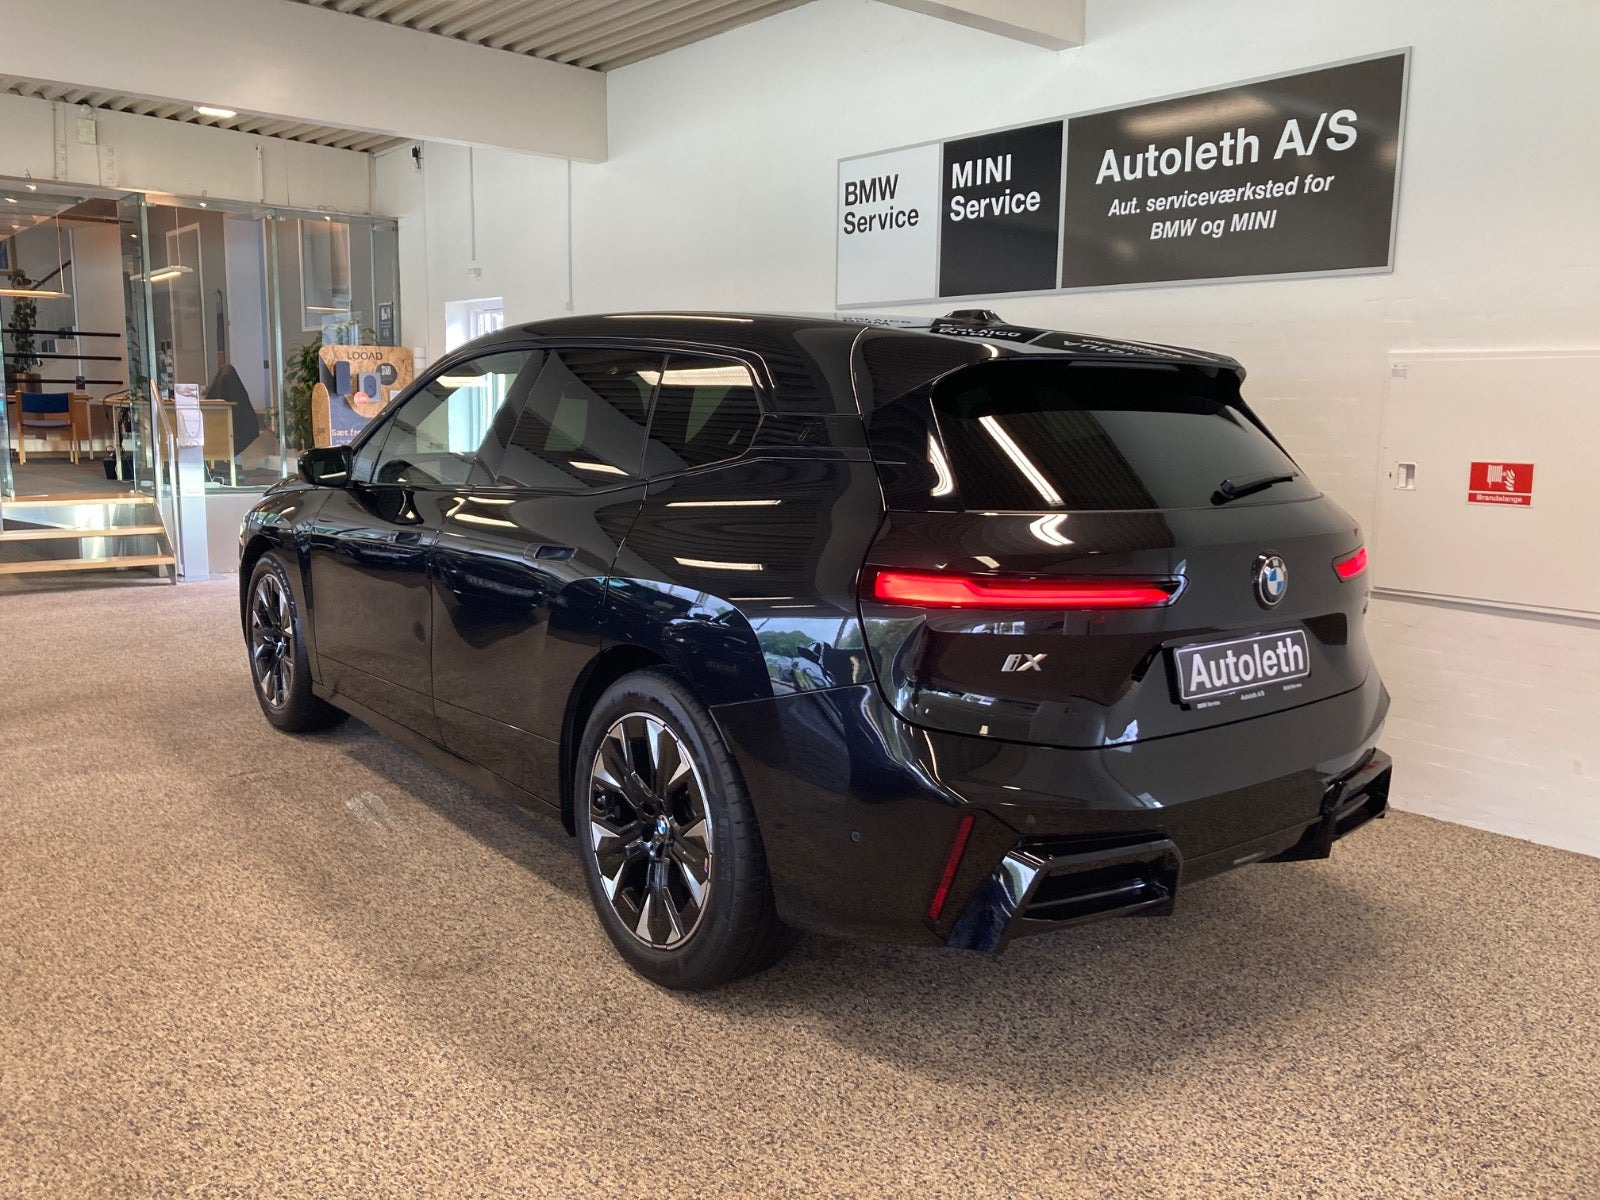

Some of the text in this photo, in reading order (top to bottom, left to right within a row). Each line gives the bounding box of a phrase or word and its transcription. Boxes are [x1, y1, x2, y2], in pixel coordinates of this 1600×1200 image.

[1095, 109, 1358, 185] Autoleth A/S
[951, 153, 1012, 189] MINI
[844, 173, 899, 207] BMW
[950, 188, 1041, 222] Service
[1108, 174, 1335, 217] Aut. serviceværksted for
[843, 206, 919, 235] Service
[1150, 209, 1277, 240] BMW og MINI
[1476, 493, 1523, 504] Brandslange
[1189, 637, 1304, 692] Autoleth
